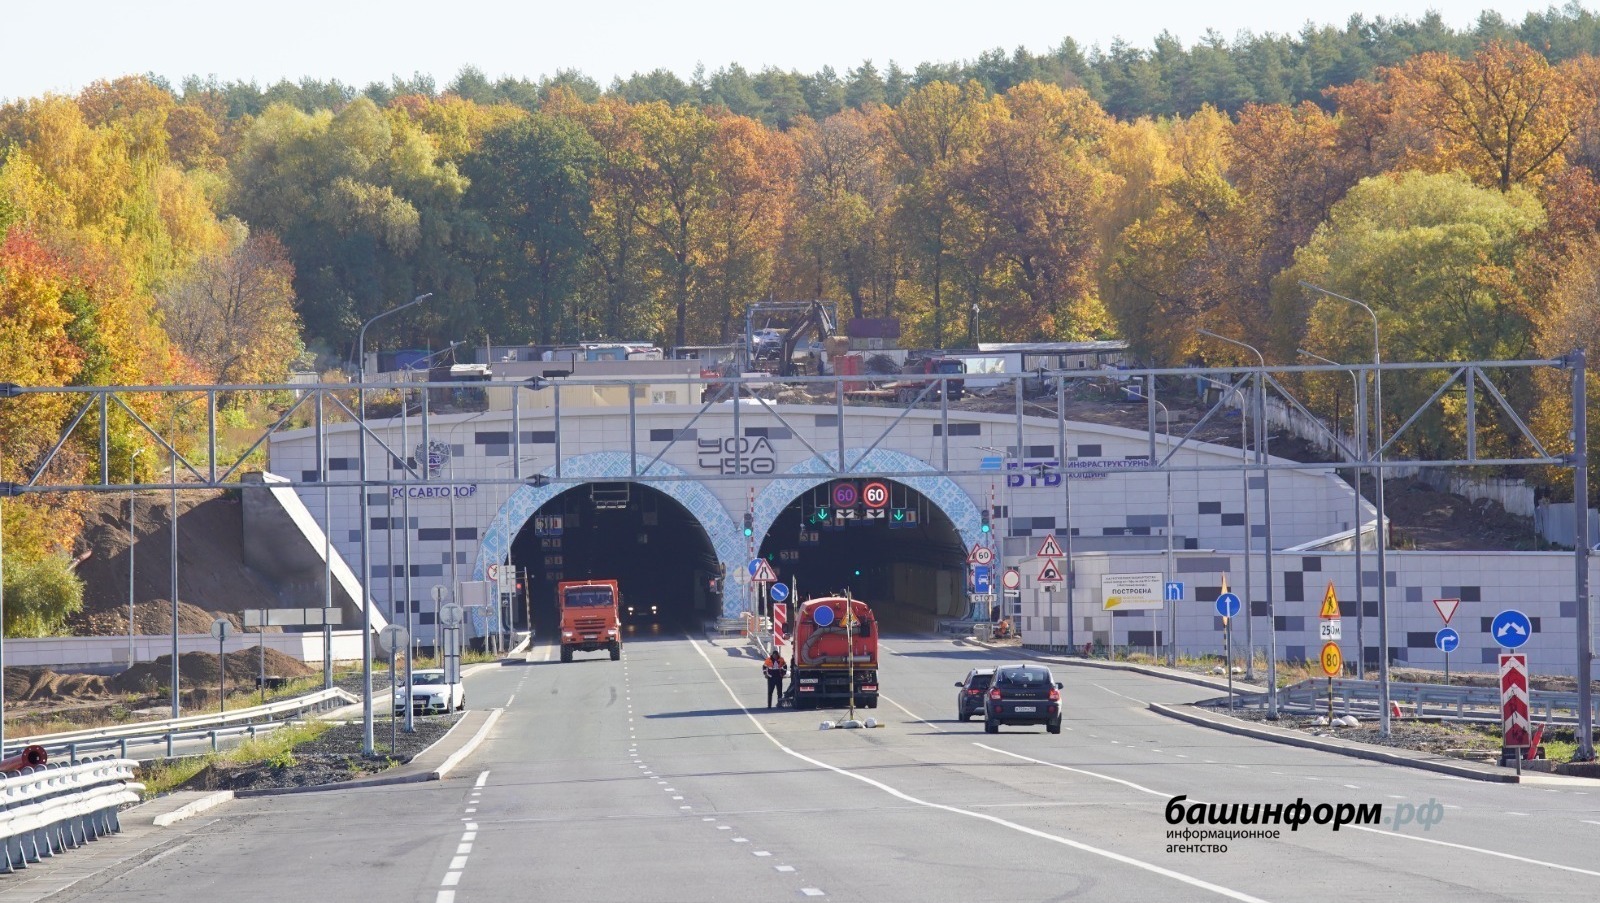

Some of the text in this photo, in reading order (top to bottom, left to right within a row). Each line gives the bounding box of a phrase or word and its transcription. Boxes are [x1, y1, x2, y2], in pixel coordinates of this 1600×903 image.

[699, 458, 775, 475] 450
[837, 489, 853, 502] 60
[867, 489, 884, 502] 60
[978, 551, 989, 560] 60
[1326, 653, 1337, 667] 80
